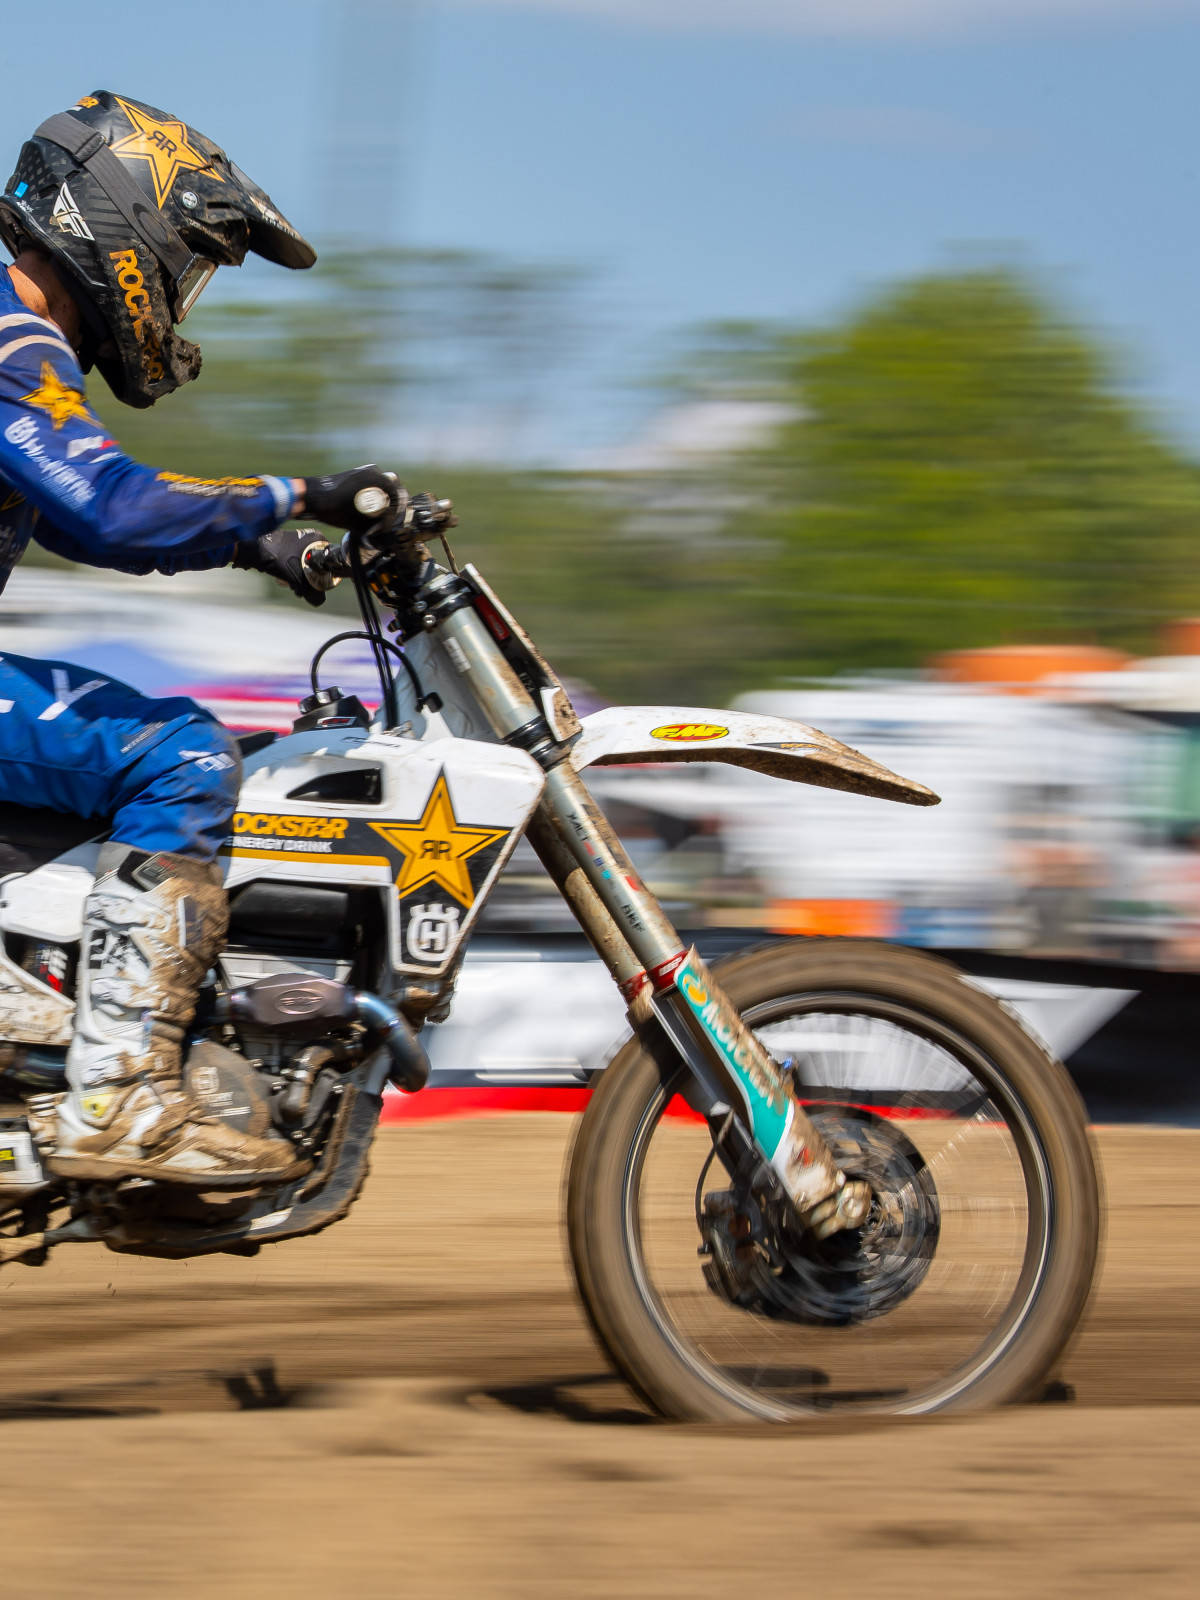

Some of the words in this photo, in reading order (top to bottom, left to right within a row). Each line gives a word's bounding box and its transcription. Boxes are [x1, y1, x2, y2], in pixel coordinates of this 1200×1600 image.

[652, 724, 730, 740] FMF
[232, 812, 349, 839] OCKSTAR
[283, 839, 333, 853] DRINK
